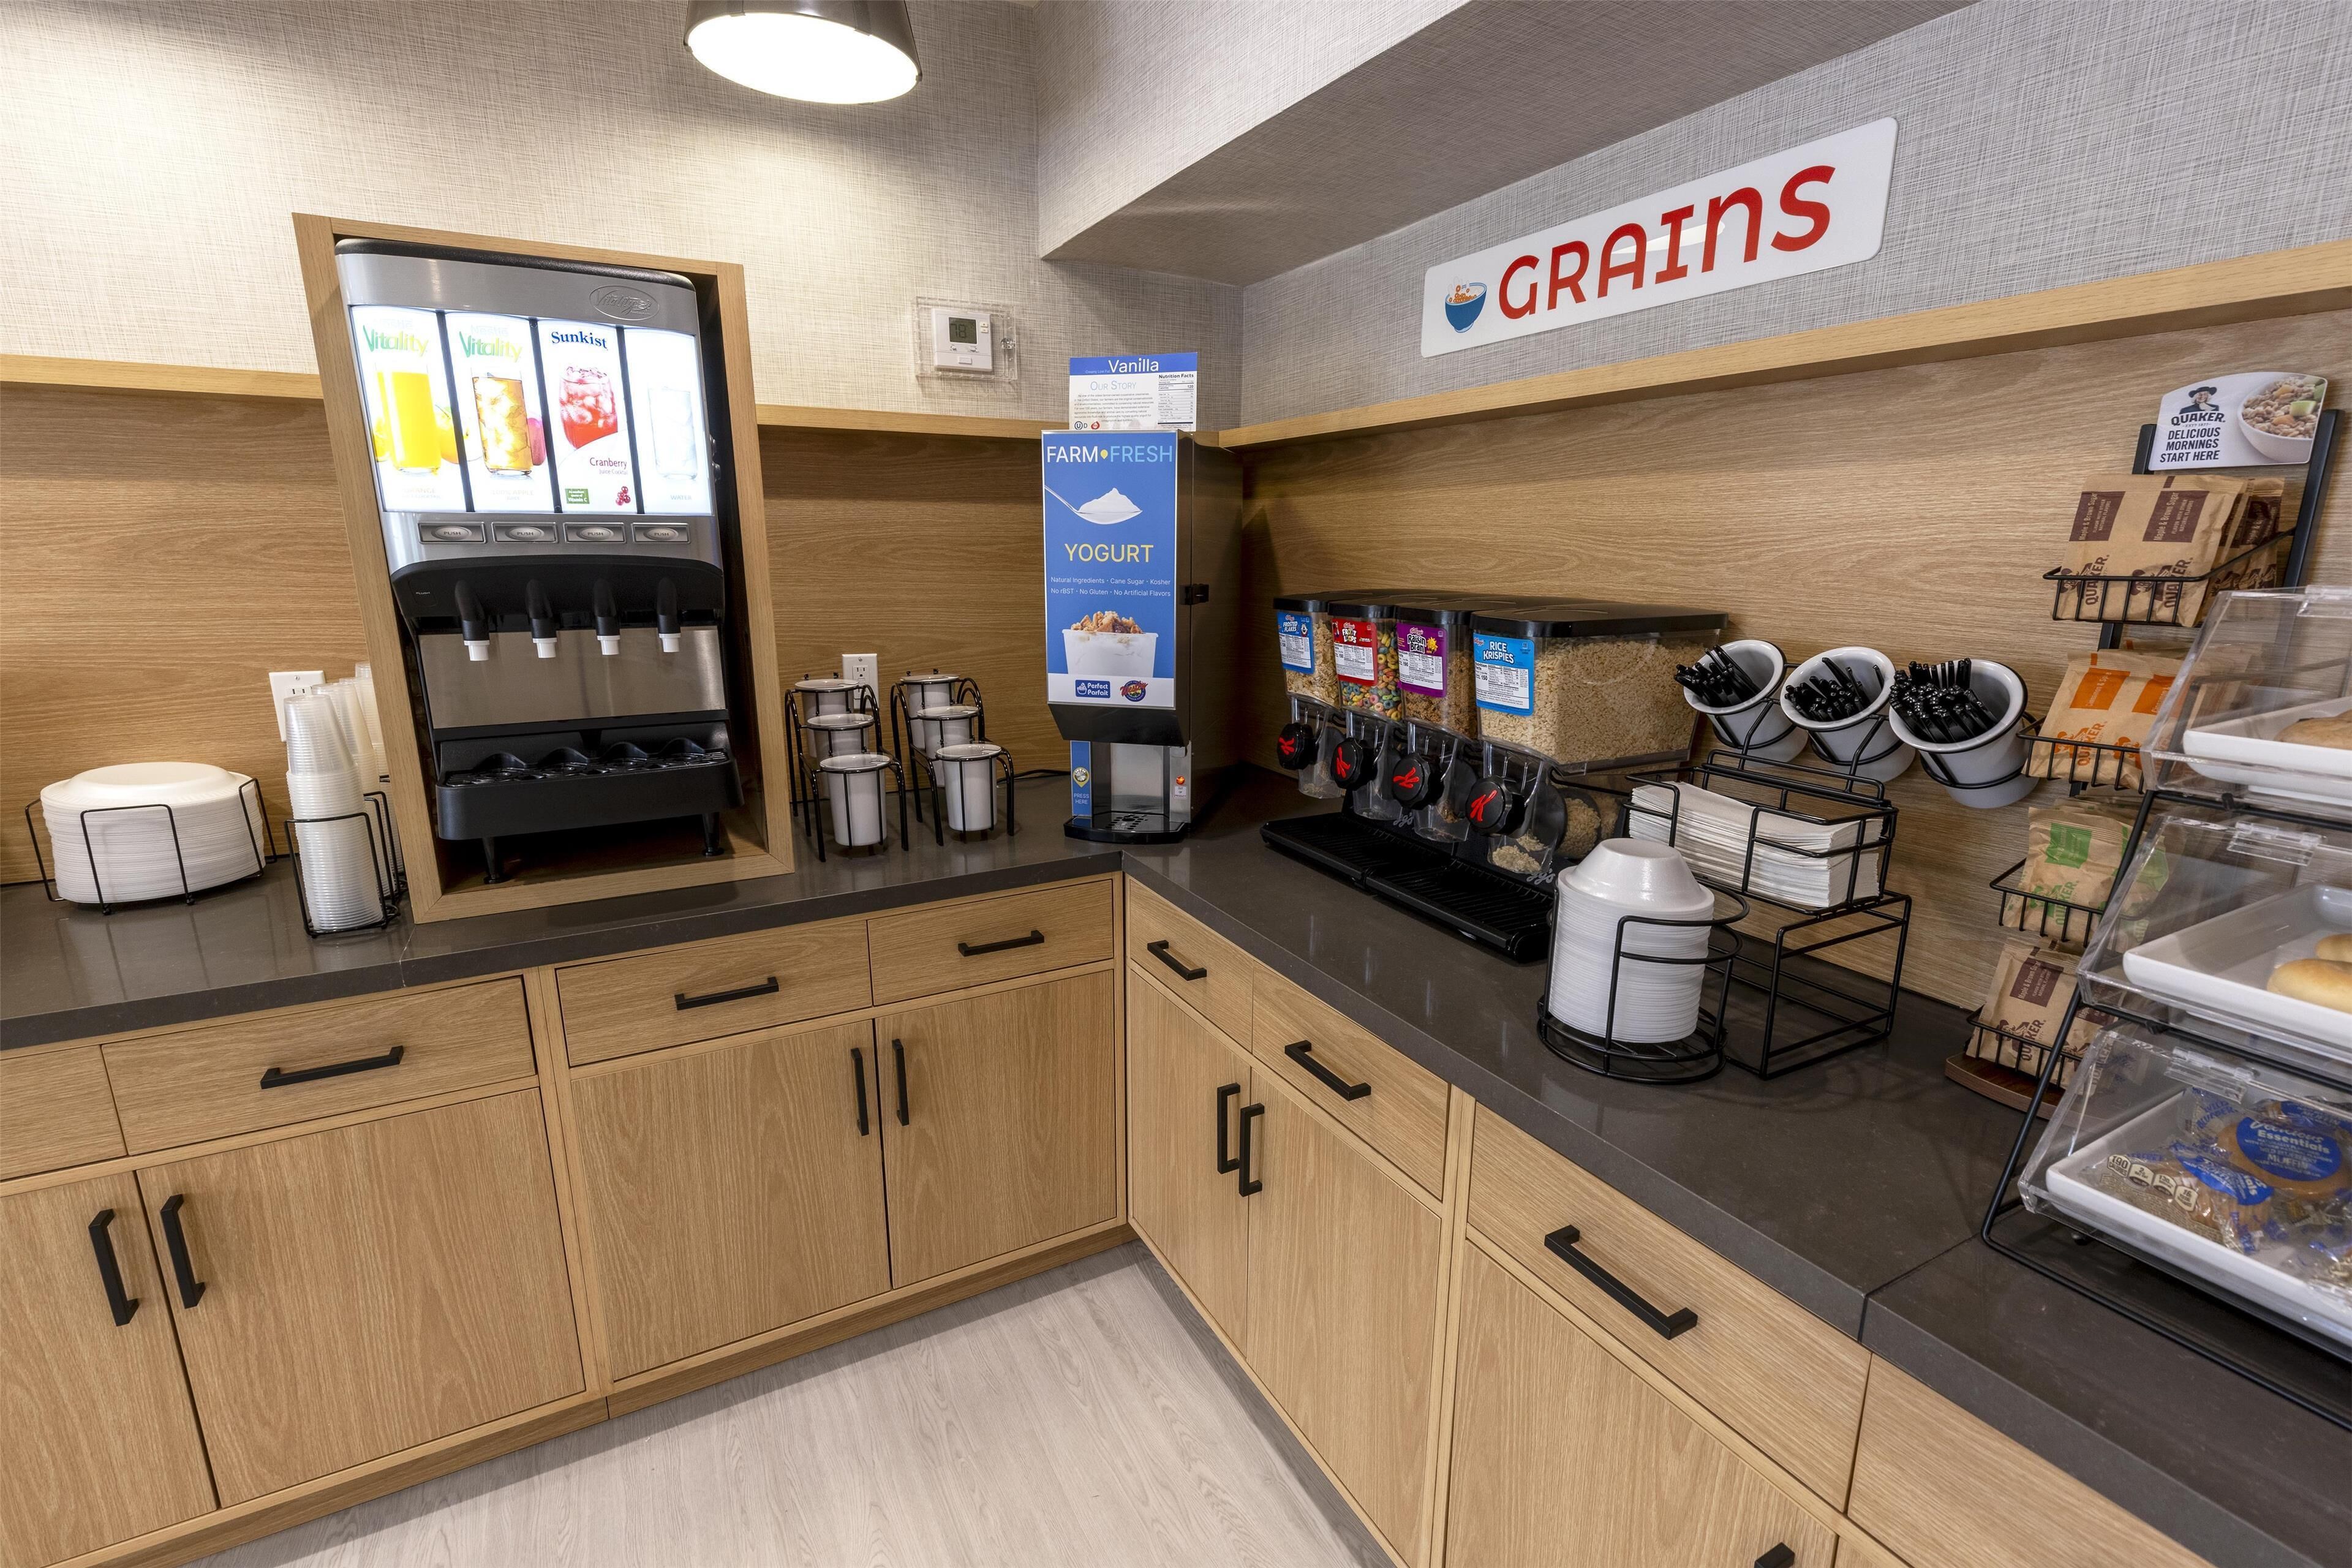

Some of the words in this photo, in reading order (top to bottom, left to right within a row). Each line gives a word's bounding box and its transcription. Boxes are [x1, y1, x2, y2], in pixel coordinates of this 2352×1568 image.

[1498, 165, 1836, 320] GRAINS
[363, 325, 429, 357] Vitality
[459, 331, 522, 363] Vitality
[551, 331, 607, 349] Sunkist
[1108, 358, 1158, 373] Vanilla
[2171, 412, 2225, 426] QUAKER
[2168, 427, 2221, 440] DELICIOUS
[2166, 439, 2220, 451] MORNINGS
[1047, 446, 1098, 462] FARM
[1110, 445, 1172, 462] FRESH
[2160, 452, 2191, 463] START
[2192, 450, 2220, 461] HERE
[589, 457, 627, 470] Cranberry
[2088, 492, 2098, 507] Sugar
[2166, 492, 2179, 507] Sugar
[2084, 505, 2094, 521] Brown
[2160, 505, 2173, 521] Brown
[2078, 527, 2090, 541] Maple
[2154, 526, 2166, 541] Maple
[1064, 543, 1154, 563] YOGURT
[2164, 559, 2192, 608] QUAER
[1408, 633, 1426, 646] Raisin
[1490, 641, 1507, 652] RICE
[1410, 643, 1425, 654] Bran
[1483, 650, 1514, 664] KRISPIES
[1470, 789, 1498, 822] K
[2018, 988, 2029, 1000] Maple
[2026, 970, 2037, 984] Brown
[2038, 983, 2047, 997] NATURAL
[2021, 1020, 2045, 1061] QUKER
[2258, 1130, 2330, 1154] Essentials
[2112, 1155, 2128, 1169] 190
